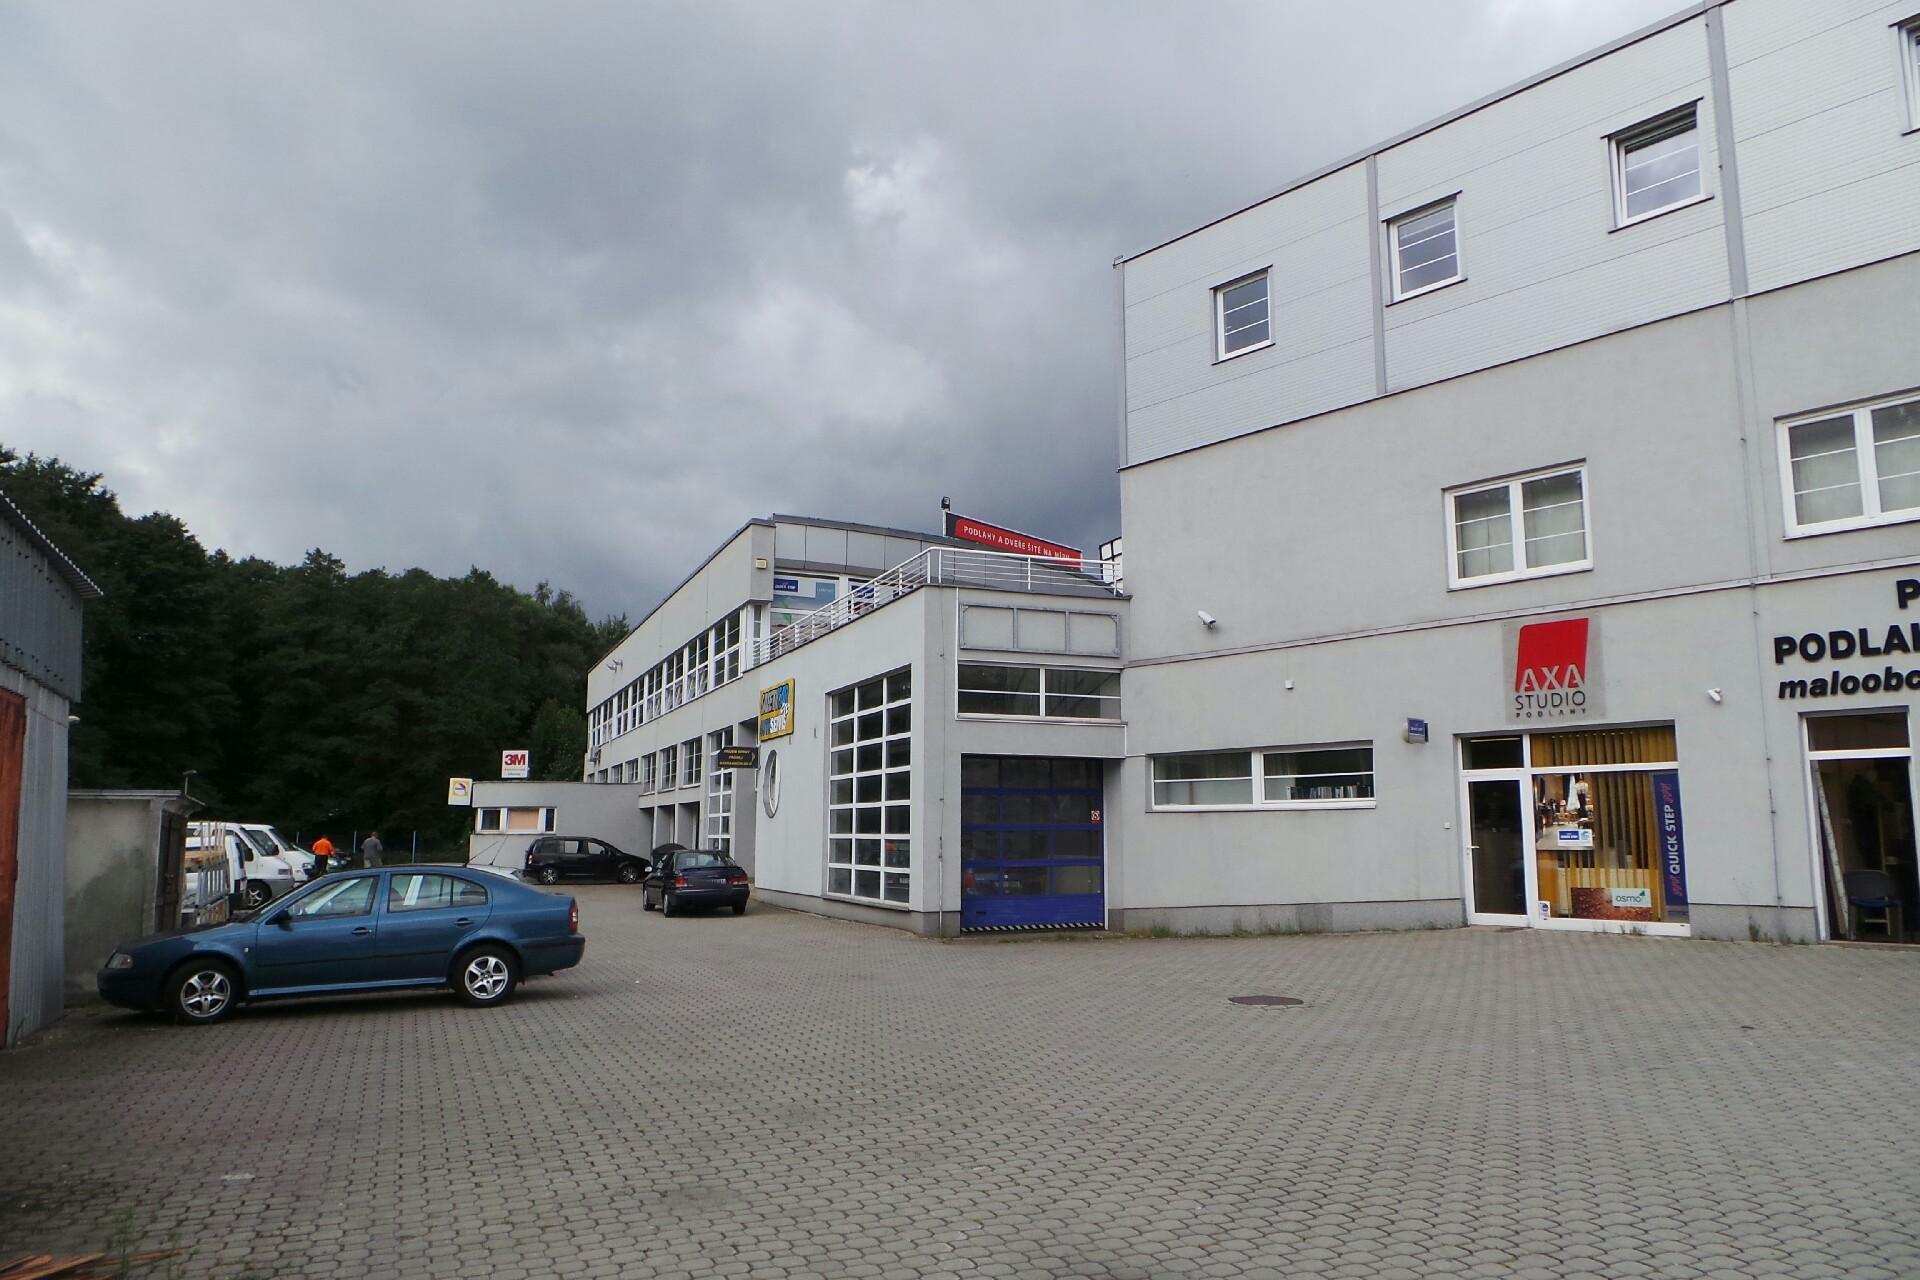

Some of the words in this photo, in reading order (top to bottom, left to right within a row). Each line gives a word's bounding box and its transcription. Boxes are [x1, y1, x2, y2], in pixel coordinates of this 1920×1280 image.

[963, 525, 996, 541] PODLAHY
[998, 535, 1003, 544] A
[1027, 542, 1041, 554] ŠITÉ
[1043, 548, 1052, 557] NA
[1519, 663, 1585, 693] AXA
[1515, 690, 1586, 711] STUDIO
[1516, 707, 1587, 719] PODLAHY
[504, 753, 526, 766] 3M
[1615, 895, 1642, 903] osmo
